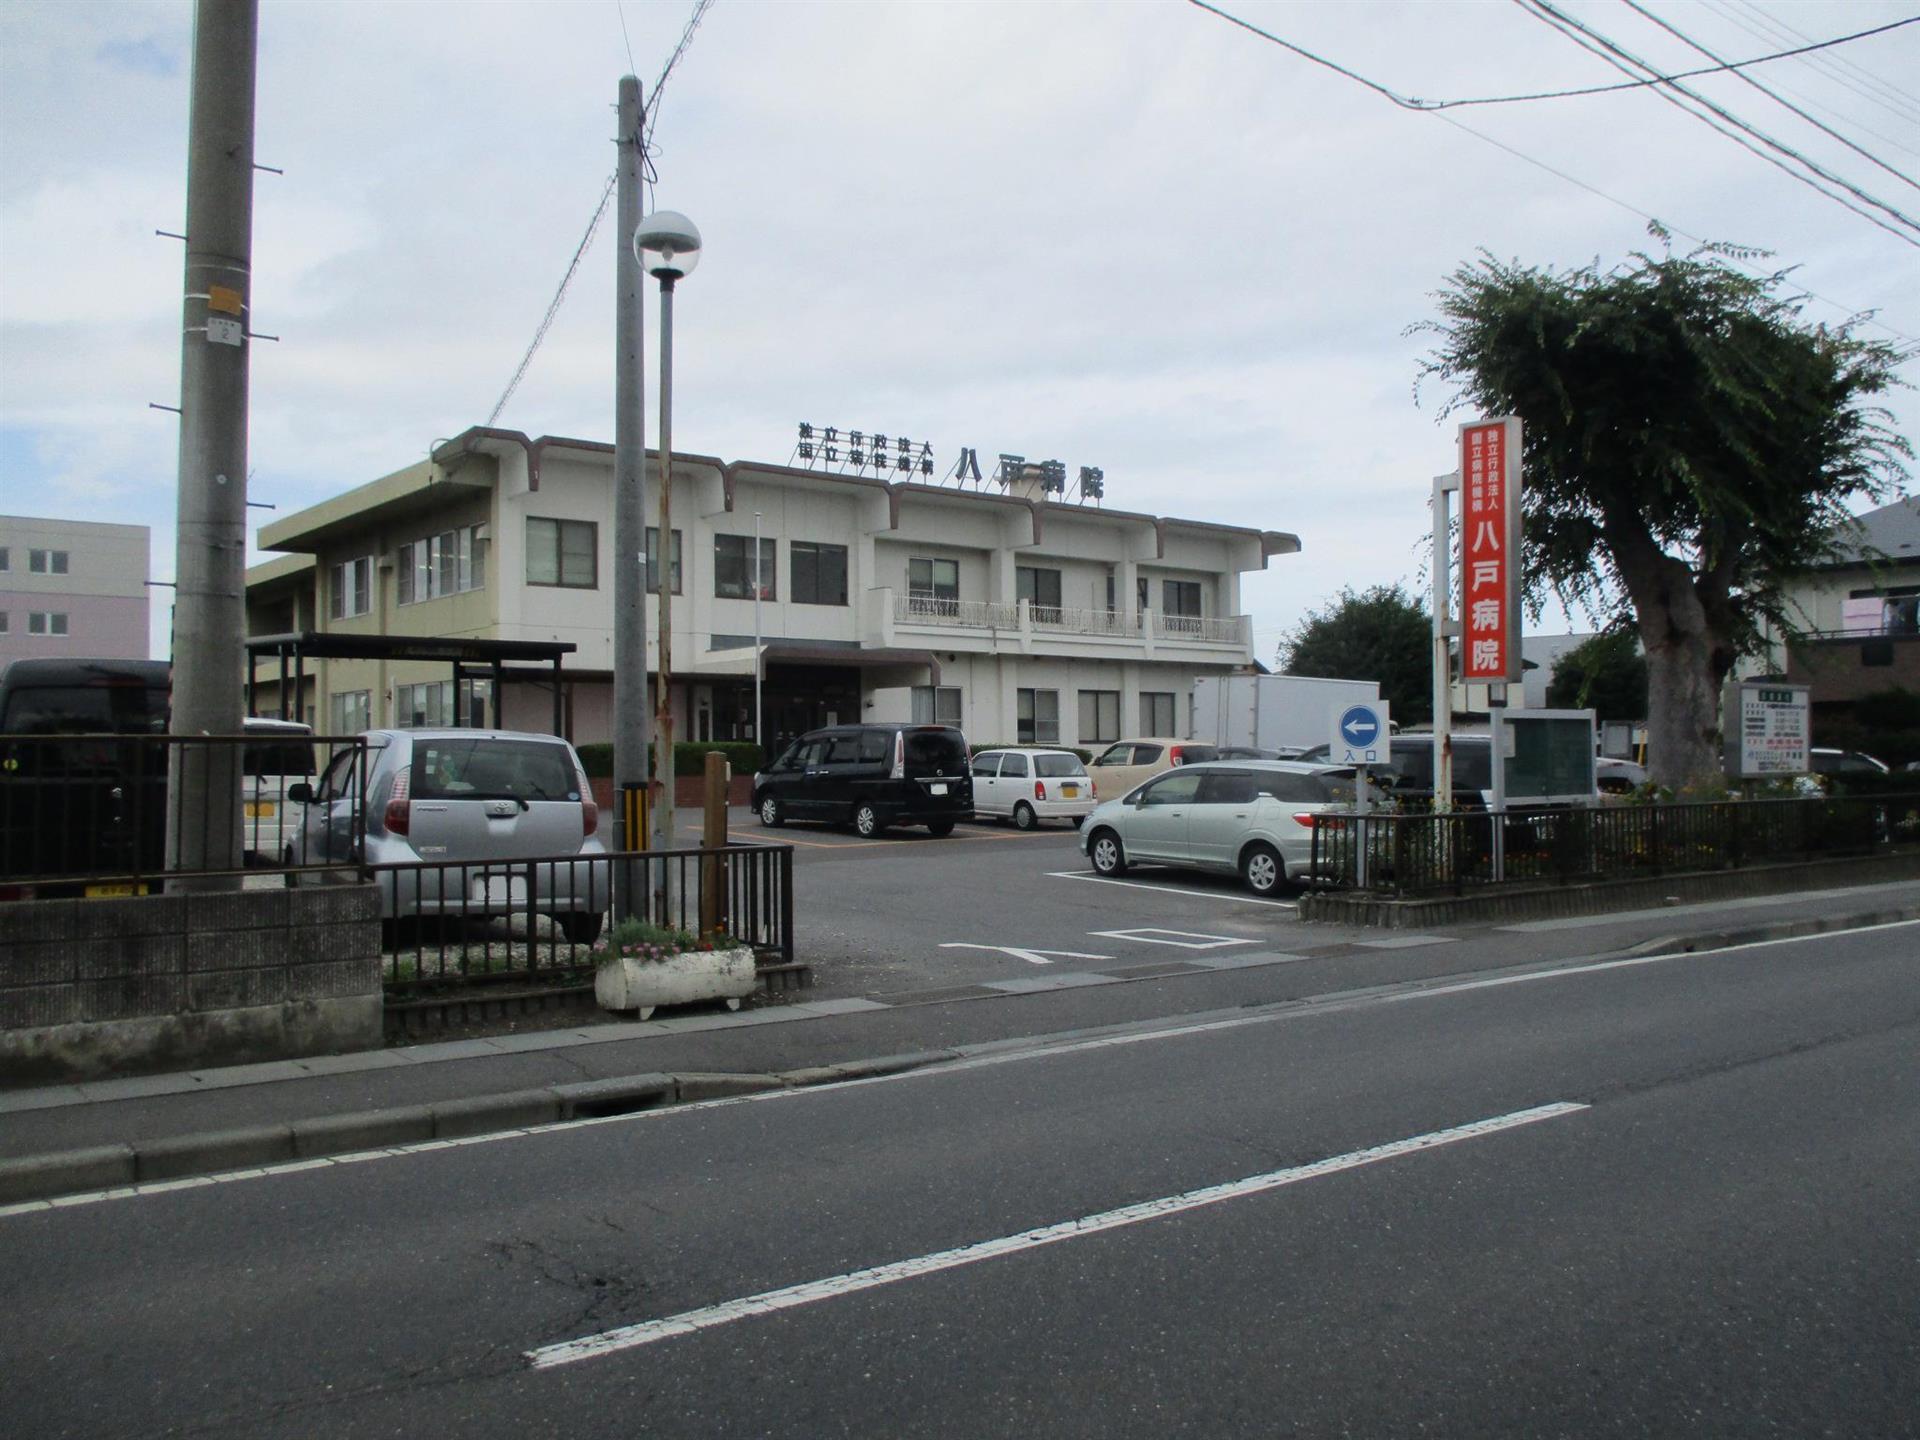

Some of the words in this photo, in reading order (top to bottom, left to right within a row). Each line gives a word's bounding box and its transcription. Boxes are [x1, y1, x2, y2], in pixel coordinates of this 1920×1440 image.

[955, 447, 1104, 499] 八戸病院
[1487, 429, 1499, 511] 独立行政法人
[1471, 519, 1500, 672] 八戸病院
[1343, 749, 1376, 762] 入口
